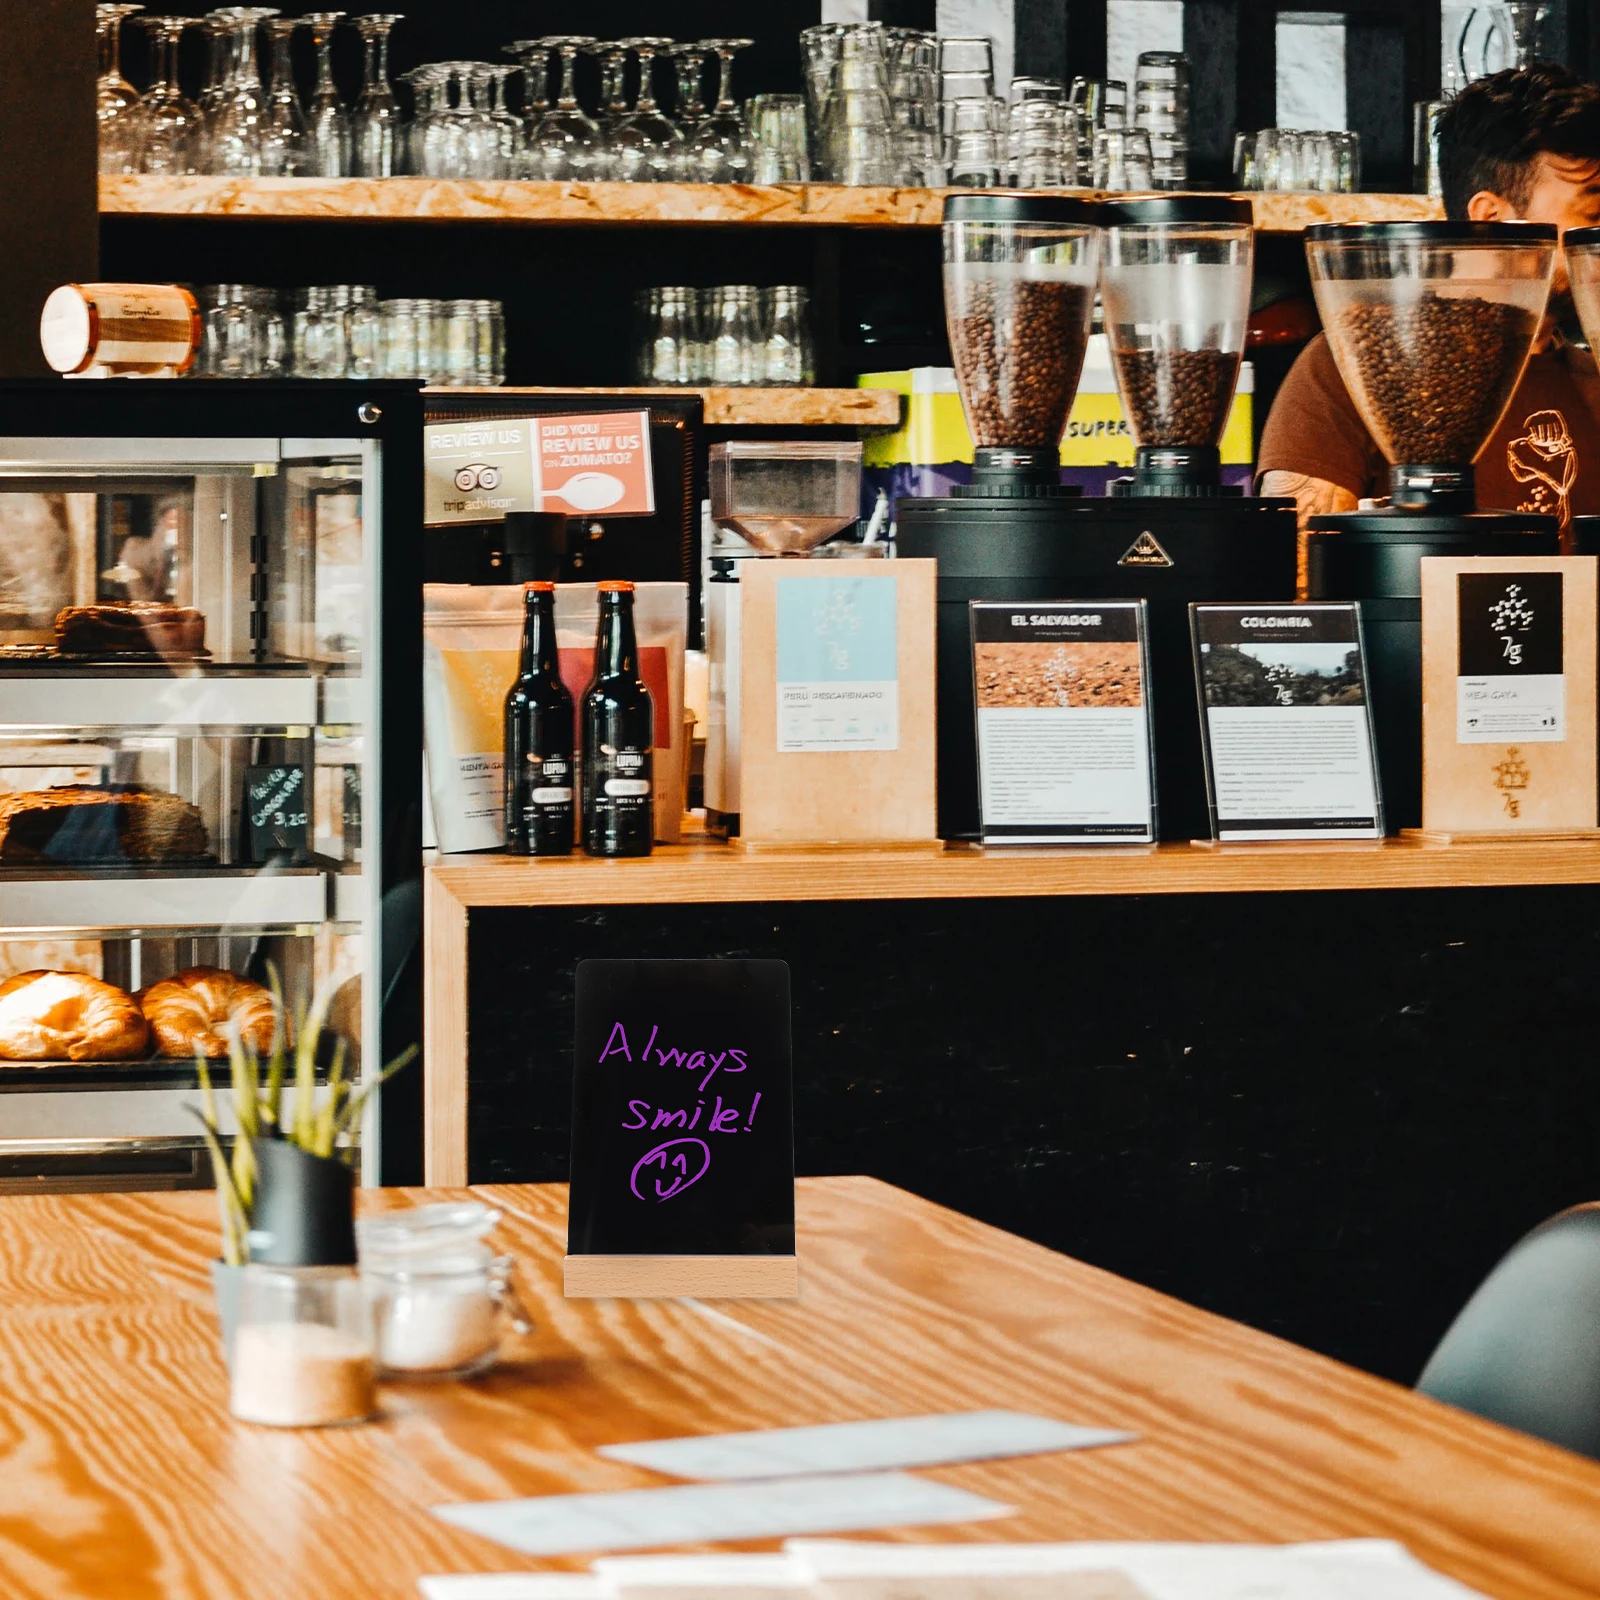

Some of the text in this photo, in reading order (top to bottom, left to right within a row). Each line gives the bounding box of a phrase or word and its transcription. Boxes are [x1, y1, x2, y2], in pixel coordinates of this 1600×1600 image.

[542, 423, 599, 437] DID YOU
[1067, 420, 1130, 437] SUPER
[430, 429, 522, 449] REVIEW US
[542, 435, 640, 453] REVIEW US
[560, 452, 632, 467] ZOMATO?
[443, 497, 517, 513] tripadvisor
[1011, 614, 1102, 626] EL SALVADOR
[1240, 616, 1313, 628] COLOMBIA
[1500, 635, 1523, 665] 7g
[599, 1021, 748, 1092] Always
